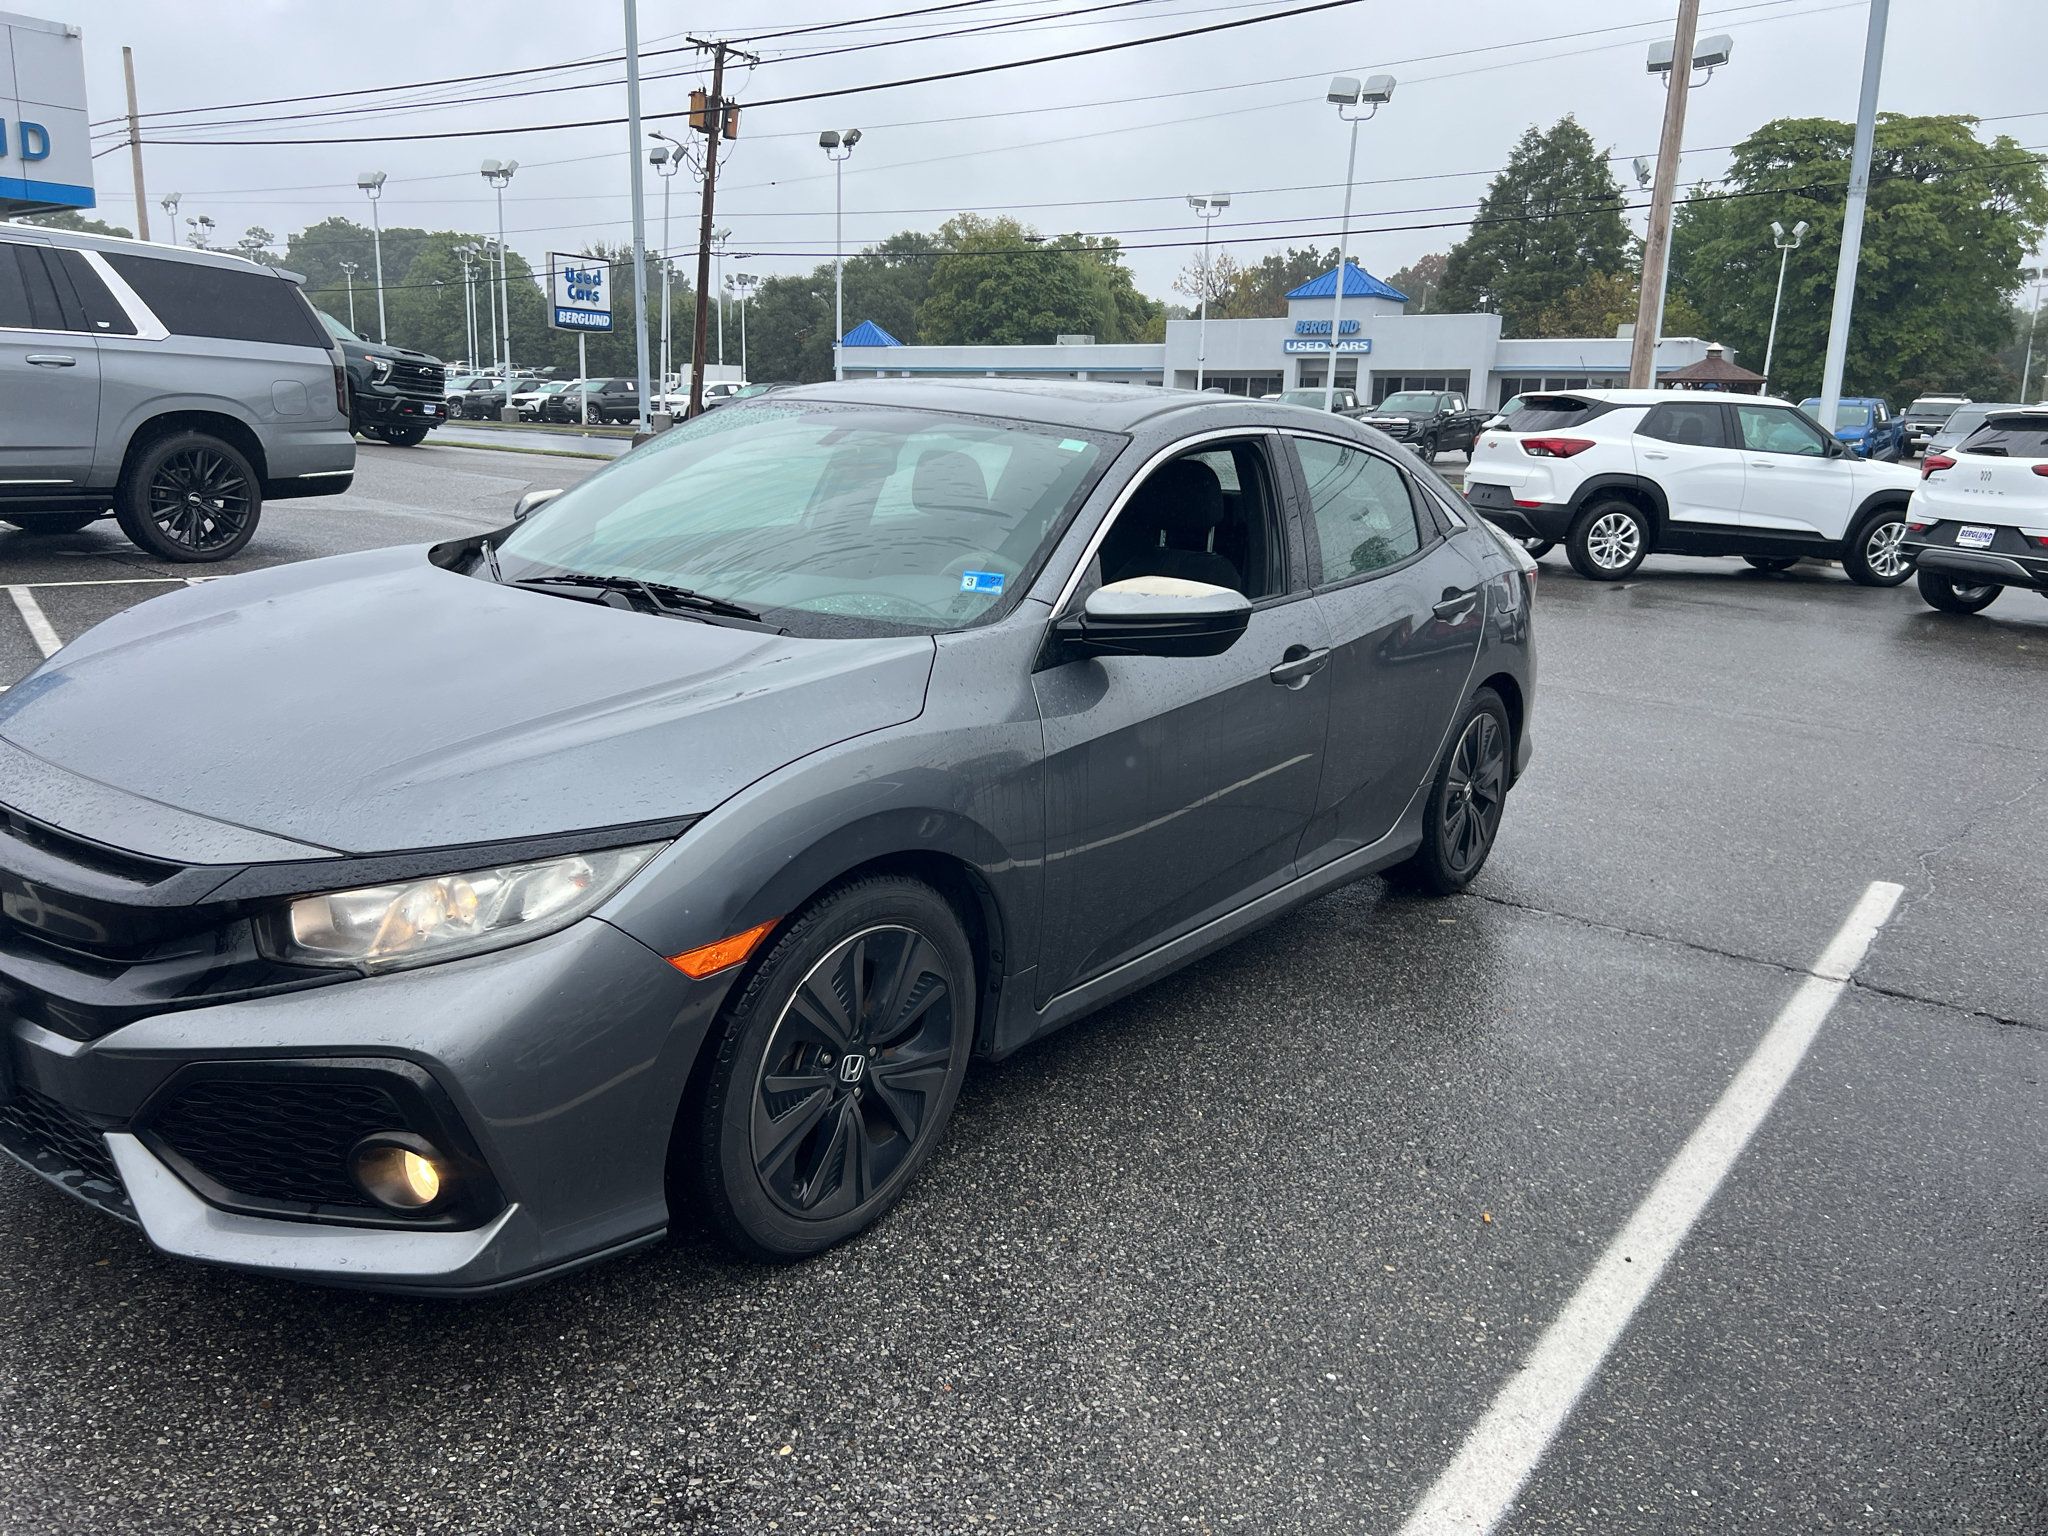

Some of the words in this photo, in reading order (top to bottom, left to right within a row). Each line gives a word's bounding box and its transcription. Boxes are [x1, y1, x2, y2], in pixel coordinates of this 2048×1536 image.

[0, 118, 50, 160] D
[564, 267, 602, 286] Used
[567, 284, 600, 302] Cars
[558, 311, 610, 326] BERGLUND
[1295, 320, 1360, 335] BERGLND
[1286, 342, 1325, 350] USED
[1329, 341, 1368, 350] ARS
[1960, 529, 1992, 539] BERGLUND
[967, 577, 974, 586] 3
